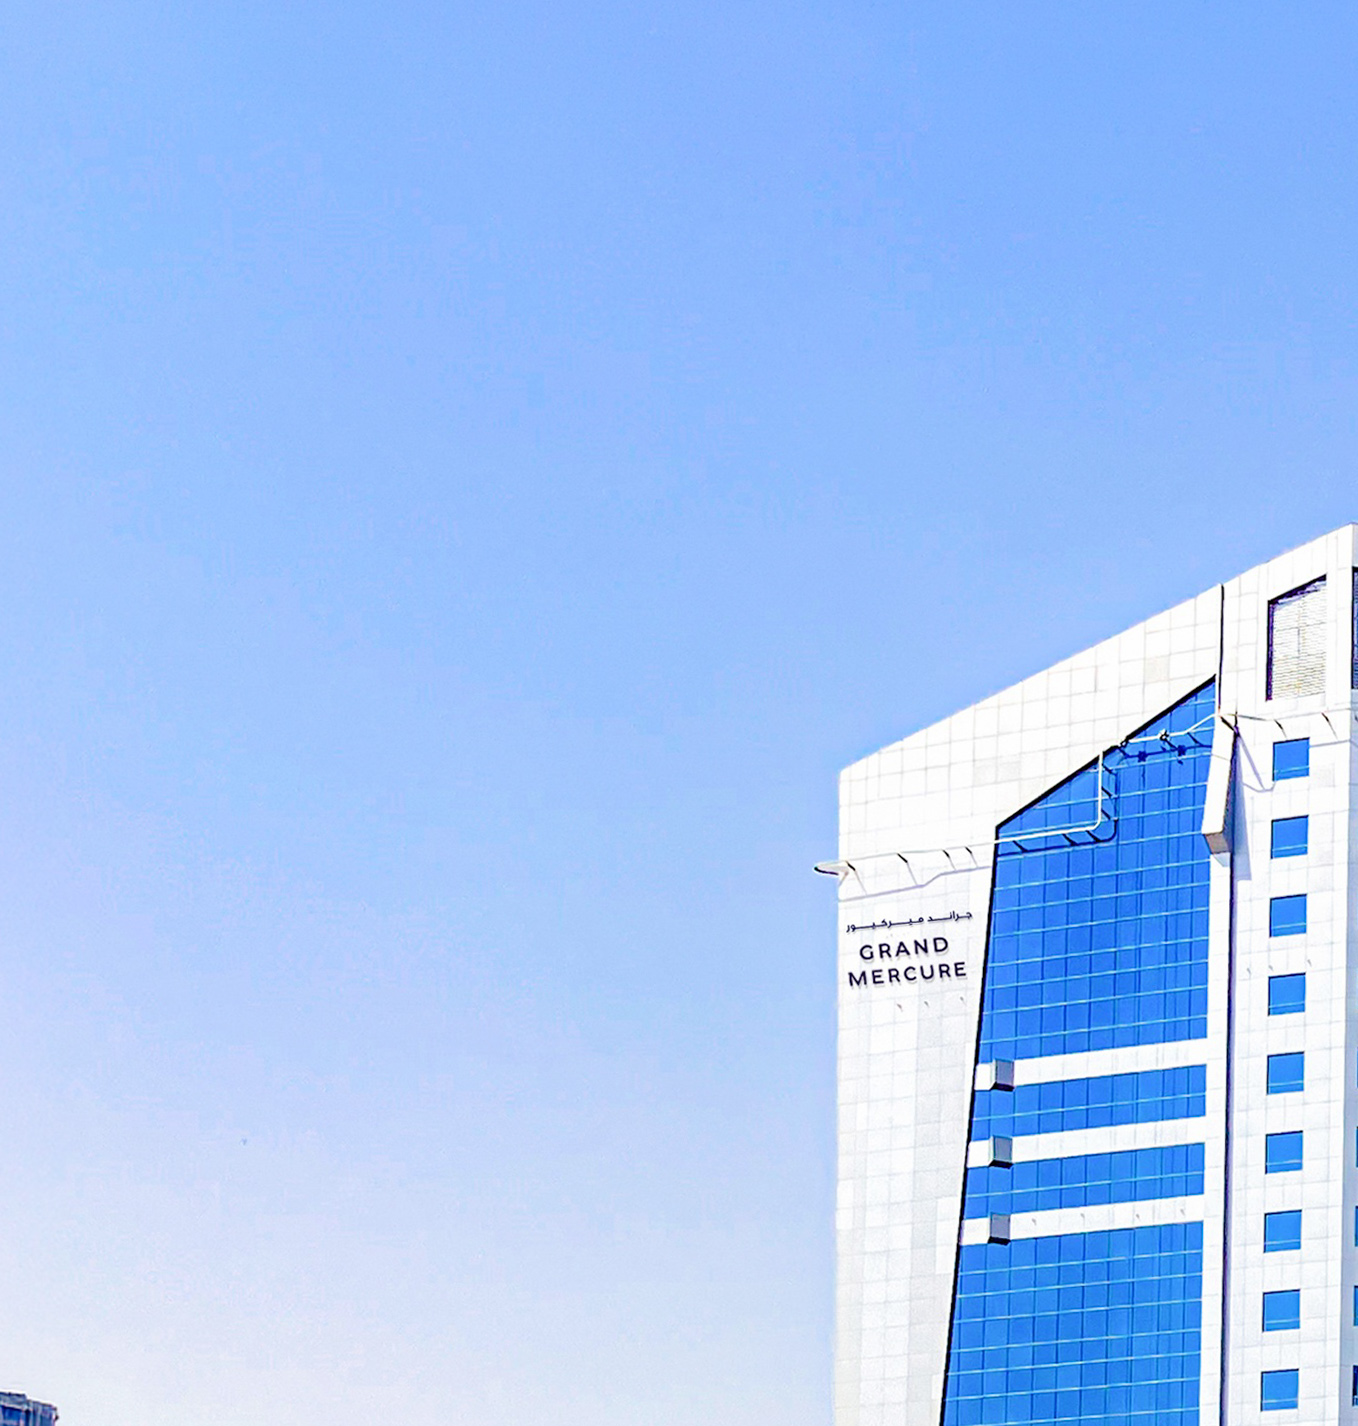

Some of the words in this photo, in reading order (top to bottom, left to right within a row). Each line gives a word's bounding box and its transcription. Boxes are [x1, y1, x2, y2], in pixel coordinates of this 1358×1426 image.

[927, 910, 973, 923] جراند
[859, 936, 949, 961] GRAND
[847, 961, 967, 987] MERCURE
